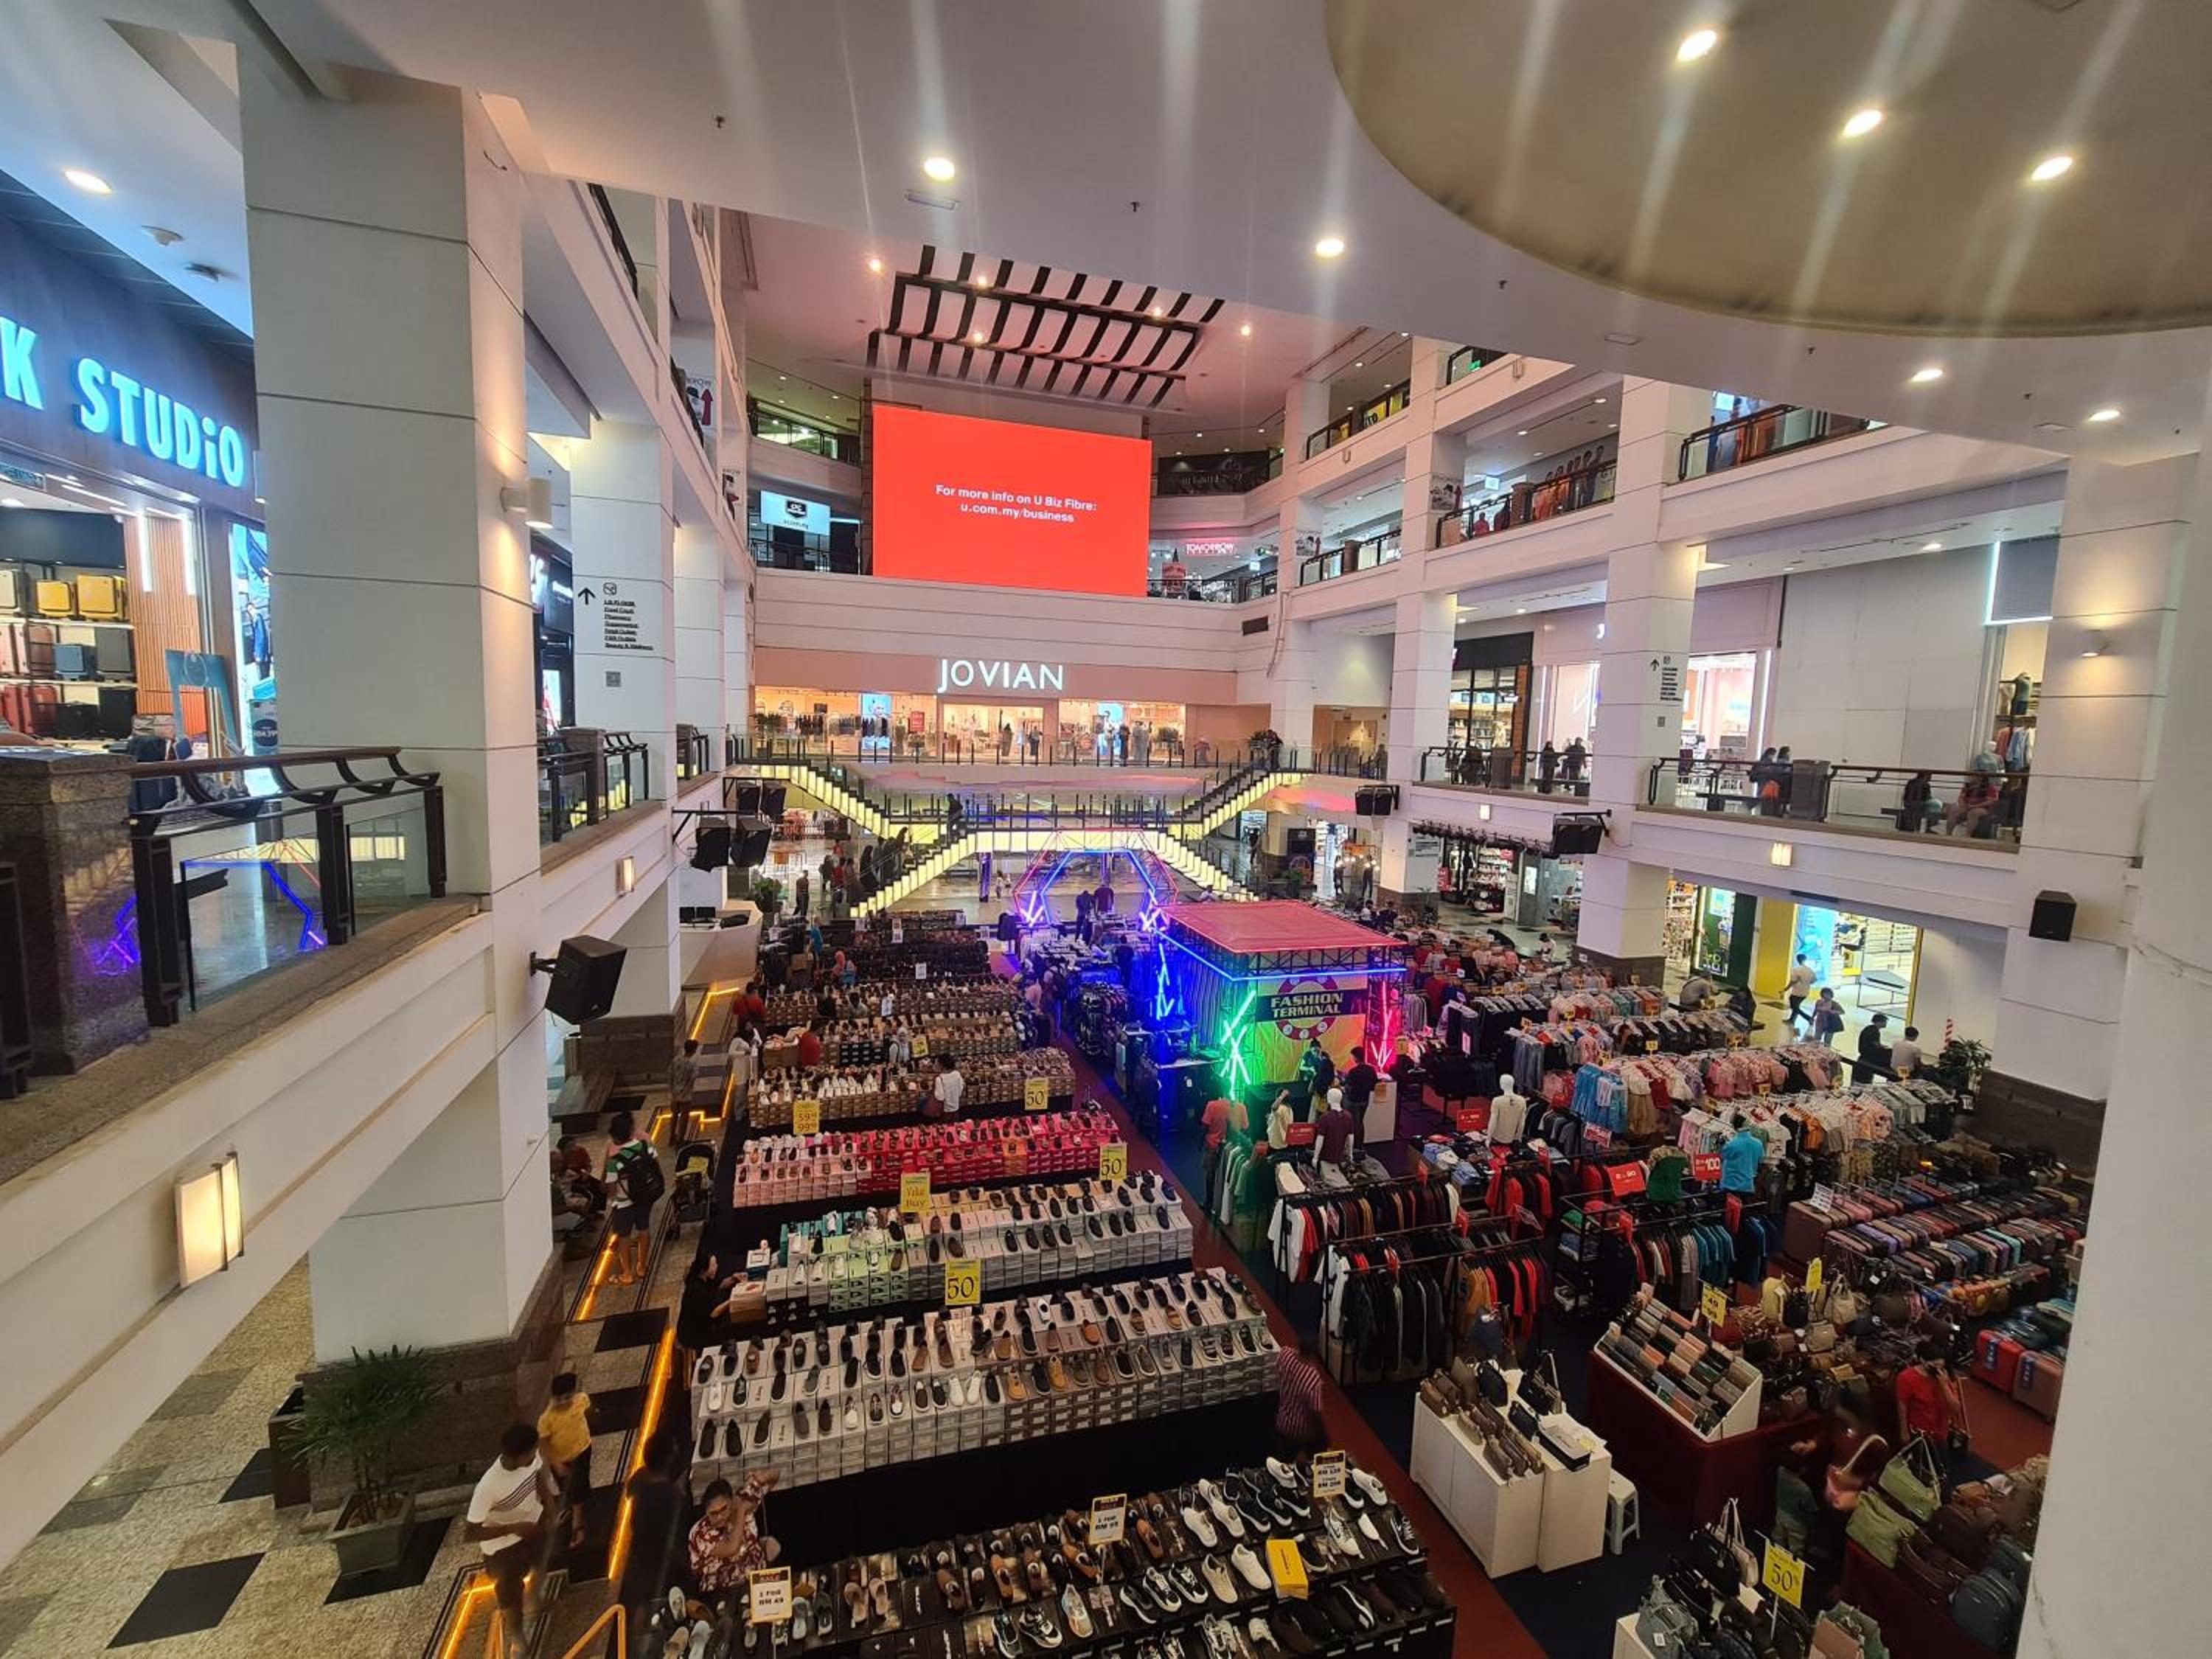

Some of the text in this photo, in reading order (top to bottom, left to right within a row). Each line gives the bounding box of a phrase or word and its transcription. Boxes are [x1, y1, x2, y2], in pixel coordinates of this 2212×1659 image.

[935, 484, 1097, 511] For more info on U Biz Fibre:
[937, 658, 1063, 693] JOVIAN
[1270, 993, 1343, 1008] FASHION
[1271, 1004, 1342, 1018] TERMINAL
